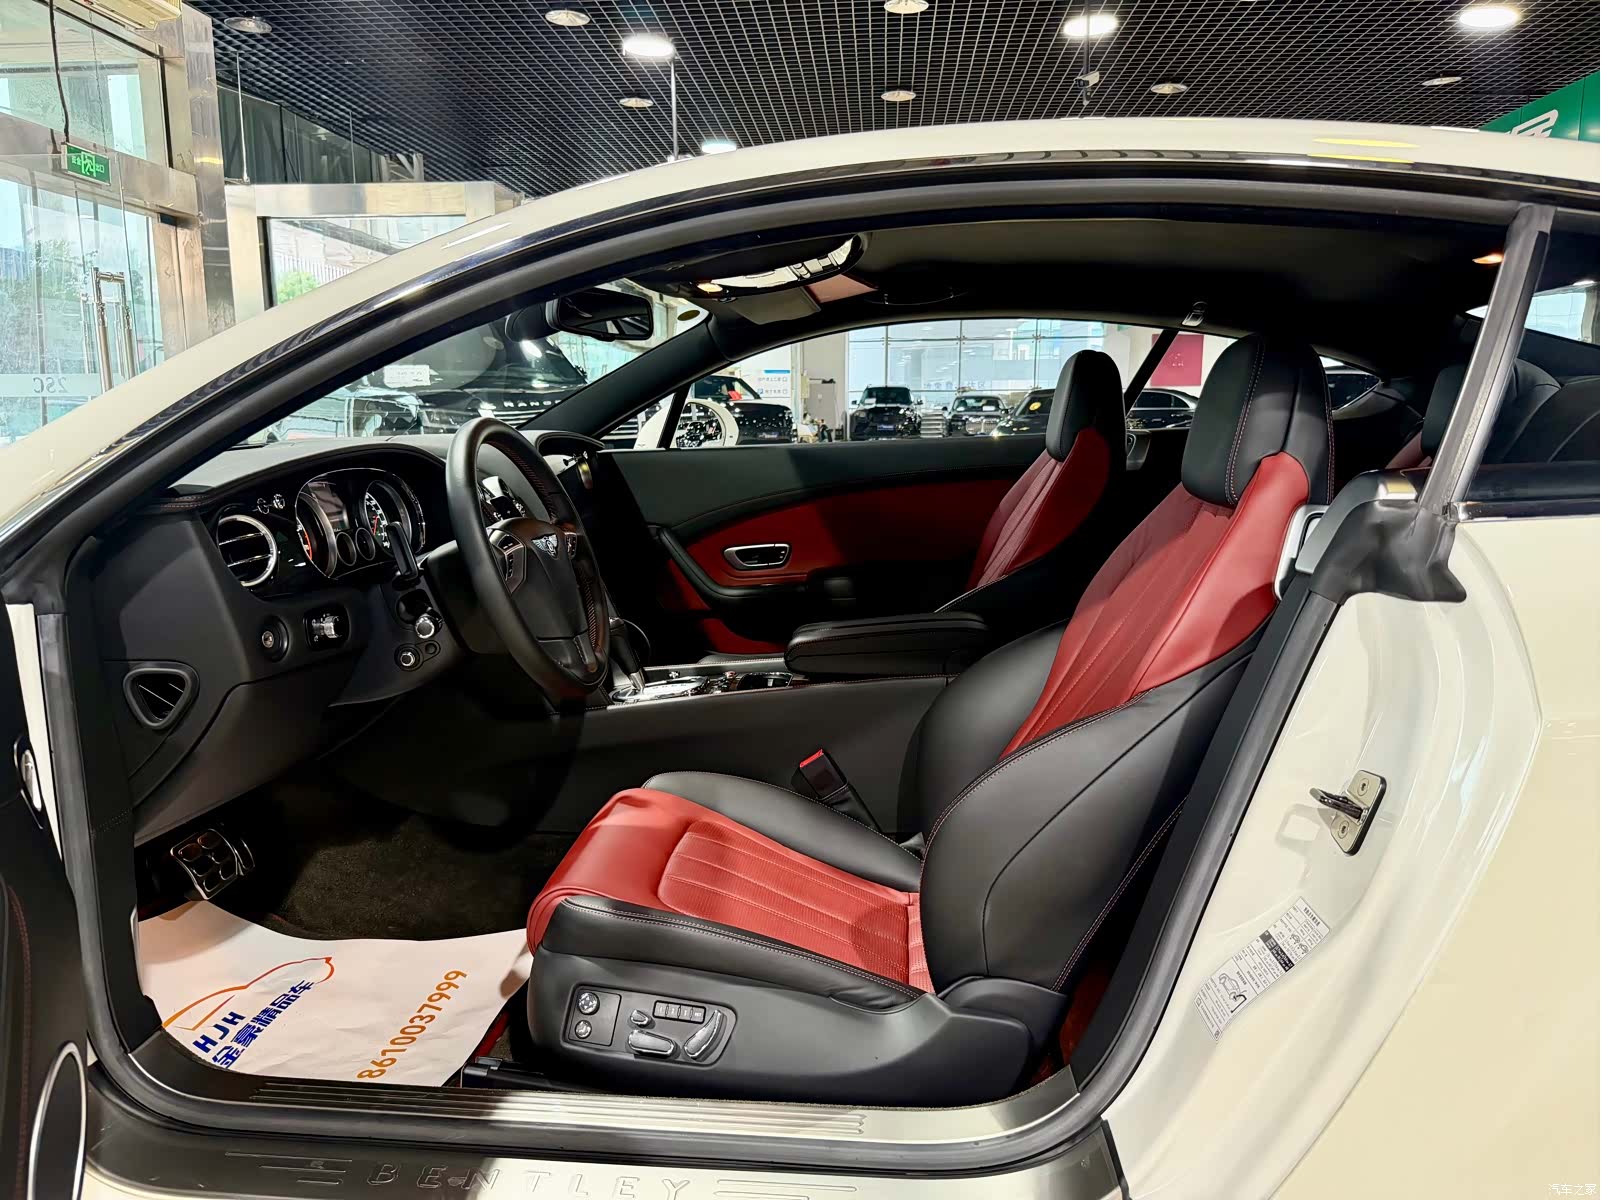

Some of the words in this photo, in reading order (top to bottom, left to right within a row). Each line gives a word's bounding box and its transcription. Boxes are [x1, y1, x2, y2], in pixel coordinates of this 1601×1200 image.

[193, 1011, 246, 1054] HJH
[211, 980, 314, 1068] 金豪精品车
[357, 970, 467, 1079] 8610037999
[367, 1164, 691, 1199] BENTLEY
